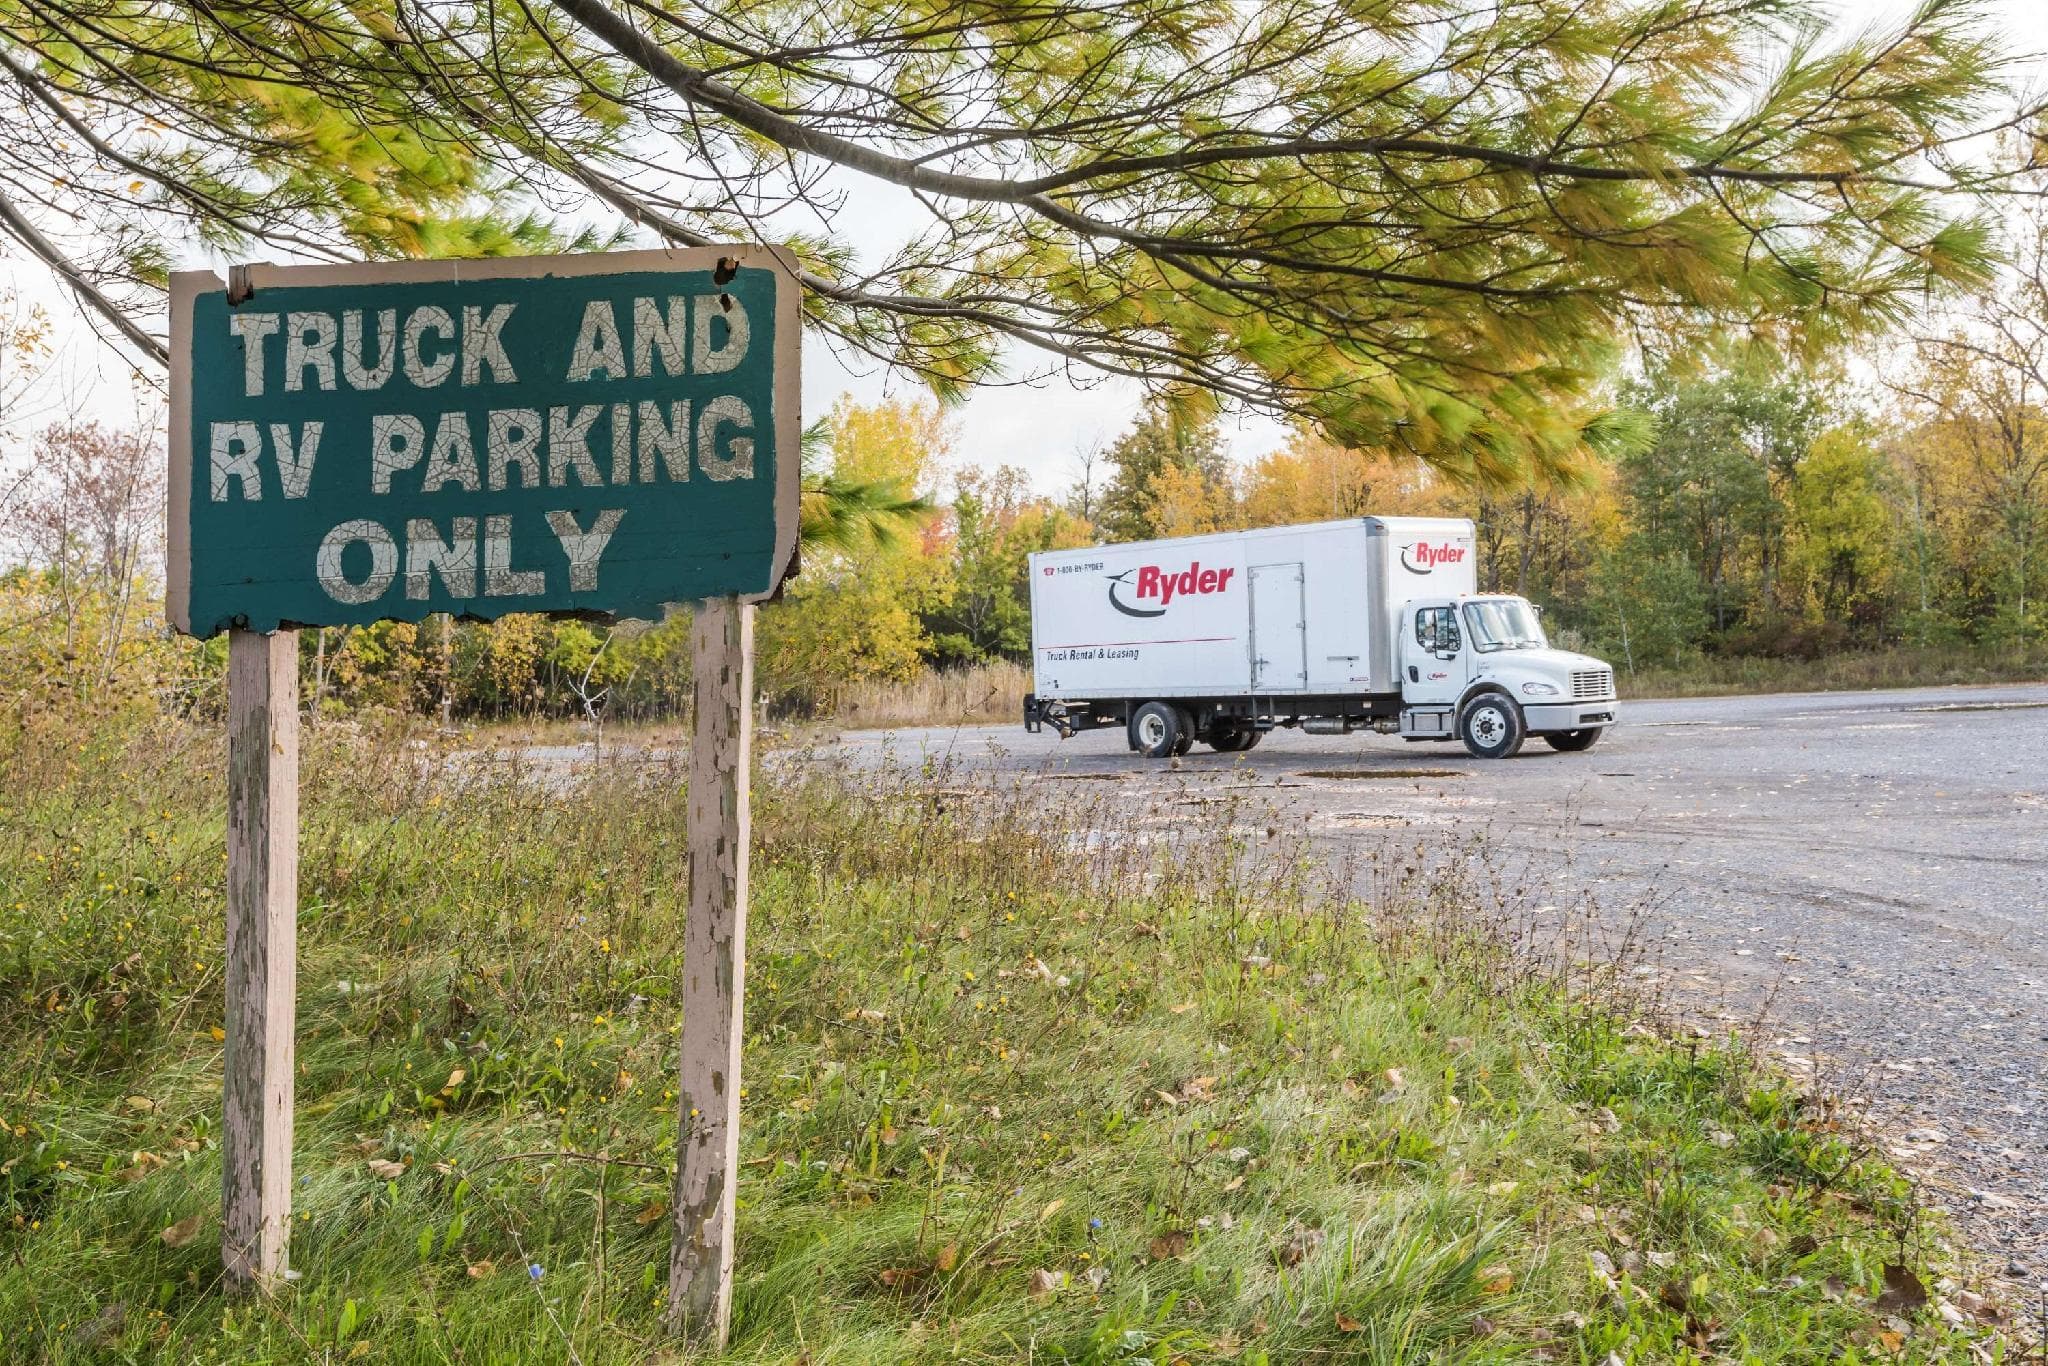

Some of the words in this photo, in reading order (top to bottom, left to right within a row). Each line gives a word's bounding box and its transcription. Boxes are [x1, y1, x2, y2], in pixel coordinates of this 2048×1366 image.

[229, 303, 520, 397] TRUCK
[566, 293, 751, 384] AND
[209, 421, 325, 502] RV
[371, 395, 755, 494] PARKING
[316, 508, 628, 605] ONLY
[1136, 562, 1235, 605] Ryder
[1416, 542, 1465, 567] Ryder
[1047, 651, 1067, 661] Truck
[1069, 649, 1096, 661] Rental
[1097, 648, 1105, 659] &
[1106, 648, 1139, 661] Leasing
